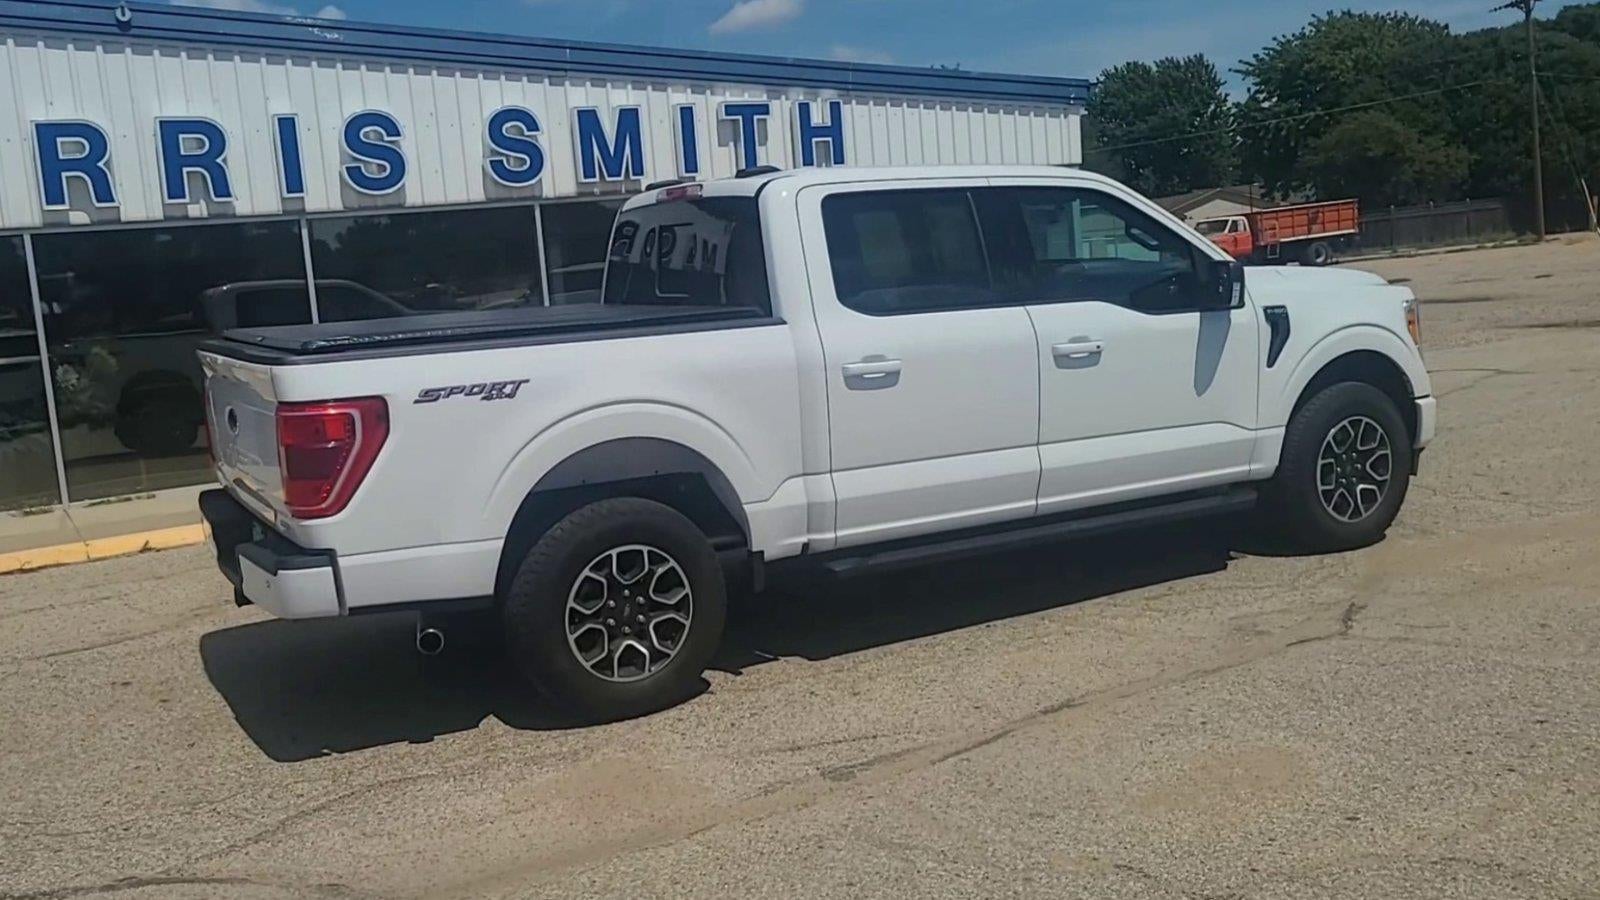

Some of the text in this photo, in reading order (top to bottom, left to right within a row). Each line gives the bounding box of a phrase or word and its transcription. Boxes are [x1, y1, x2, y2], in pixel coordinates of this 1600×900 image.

[32, 101, 846, 210] RRIS SMITH
[412, 379, 530, 404] SPORT
